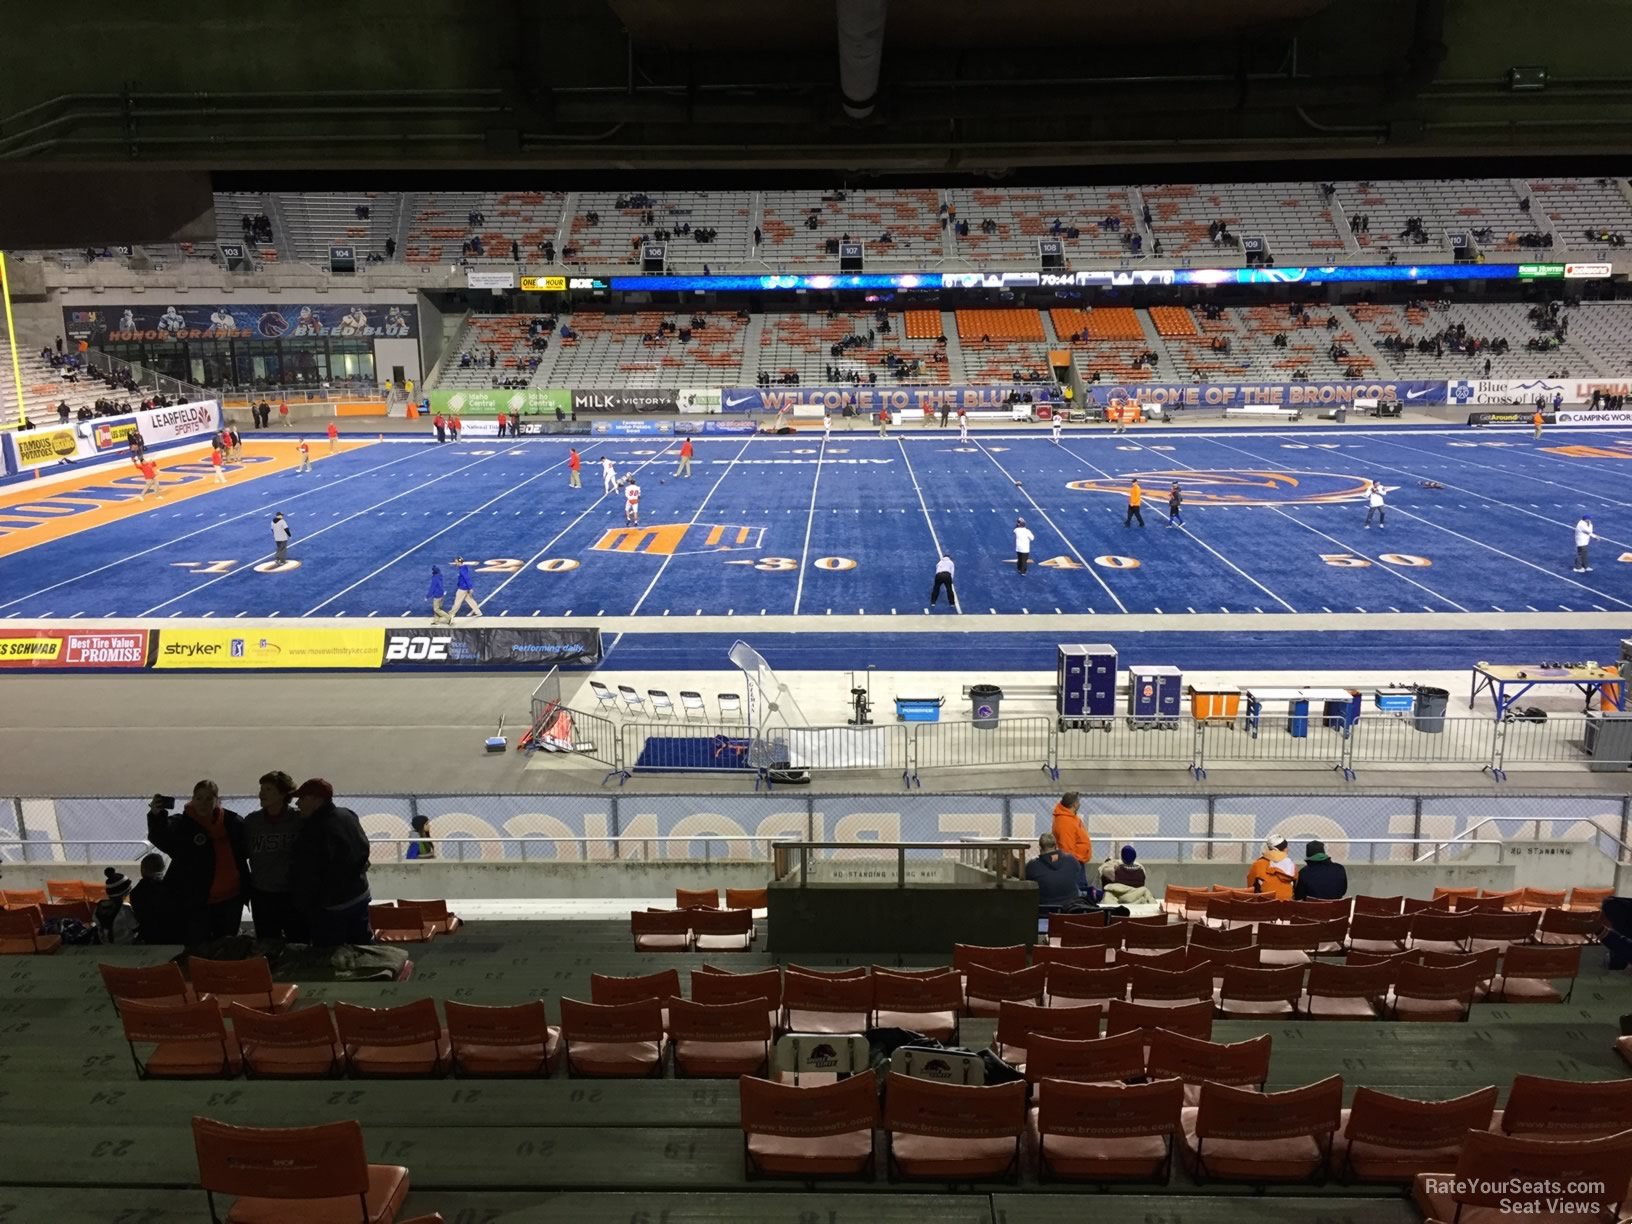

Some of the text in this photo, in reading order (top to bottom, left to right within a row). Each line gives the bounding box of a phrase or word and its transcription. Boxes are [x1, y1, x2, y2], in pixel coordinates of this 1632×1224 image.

[118, 246, 129, 254] 02
[224, 248, 238, 257] 103
[335, 249, 350, 258] 104
[845, 247, 858, 255] 107
[522, 278, 564, 287] ONE HOUR
[109, 328, 253, 342] HONOR ORANGE
[295, 326, 411, 337] BLEED BLUE
[1478, 382, 1508, 392] Blue
[762, 387, 1013, 409] WELCOME TO THE BLU
[1137, 384, 1397, 405] HOME OF THE BRONCOS
[1477, 393, 1513, 404] Cross
[1514, 393, 1527, 404] of
[468, 399, 496, 407] Central
[575, 395, 615, 408] MILK
[151, 407, 198, 429] LEARFIELD
[1573, 413, 1632, 422] CAMPING WOR
[174, 422, 200, 436] SPORTS
[19, 437, 51, 450] FAMOUS
[21, 446, 53, 461] POTATOES
[9, 643, 57, 654] SCHWAB
[70, 638, 135, 649] Best Tire Value
[164, 642, 222, 657] stryker
[386, 636, 452, 660] BOE
[512, 644, 561, 653] Performing
[80, 648, 142, 662] PROMISE
[206, 1090, 243, 1106] 23
[326, 1090, 367, 1105] 22
[90, 1139, 135, 1158] 23
[516, 1140, 556, 1158] 20
